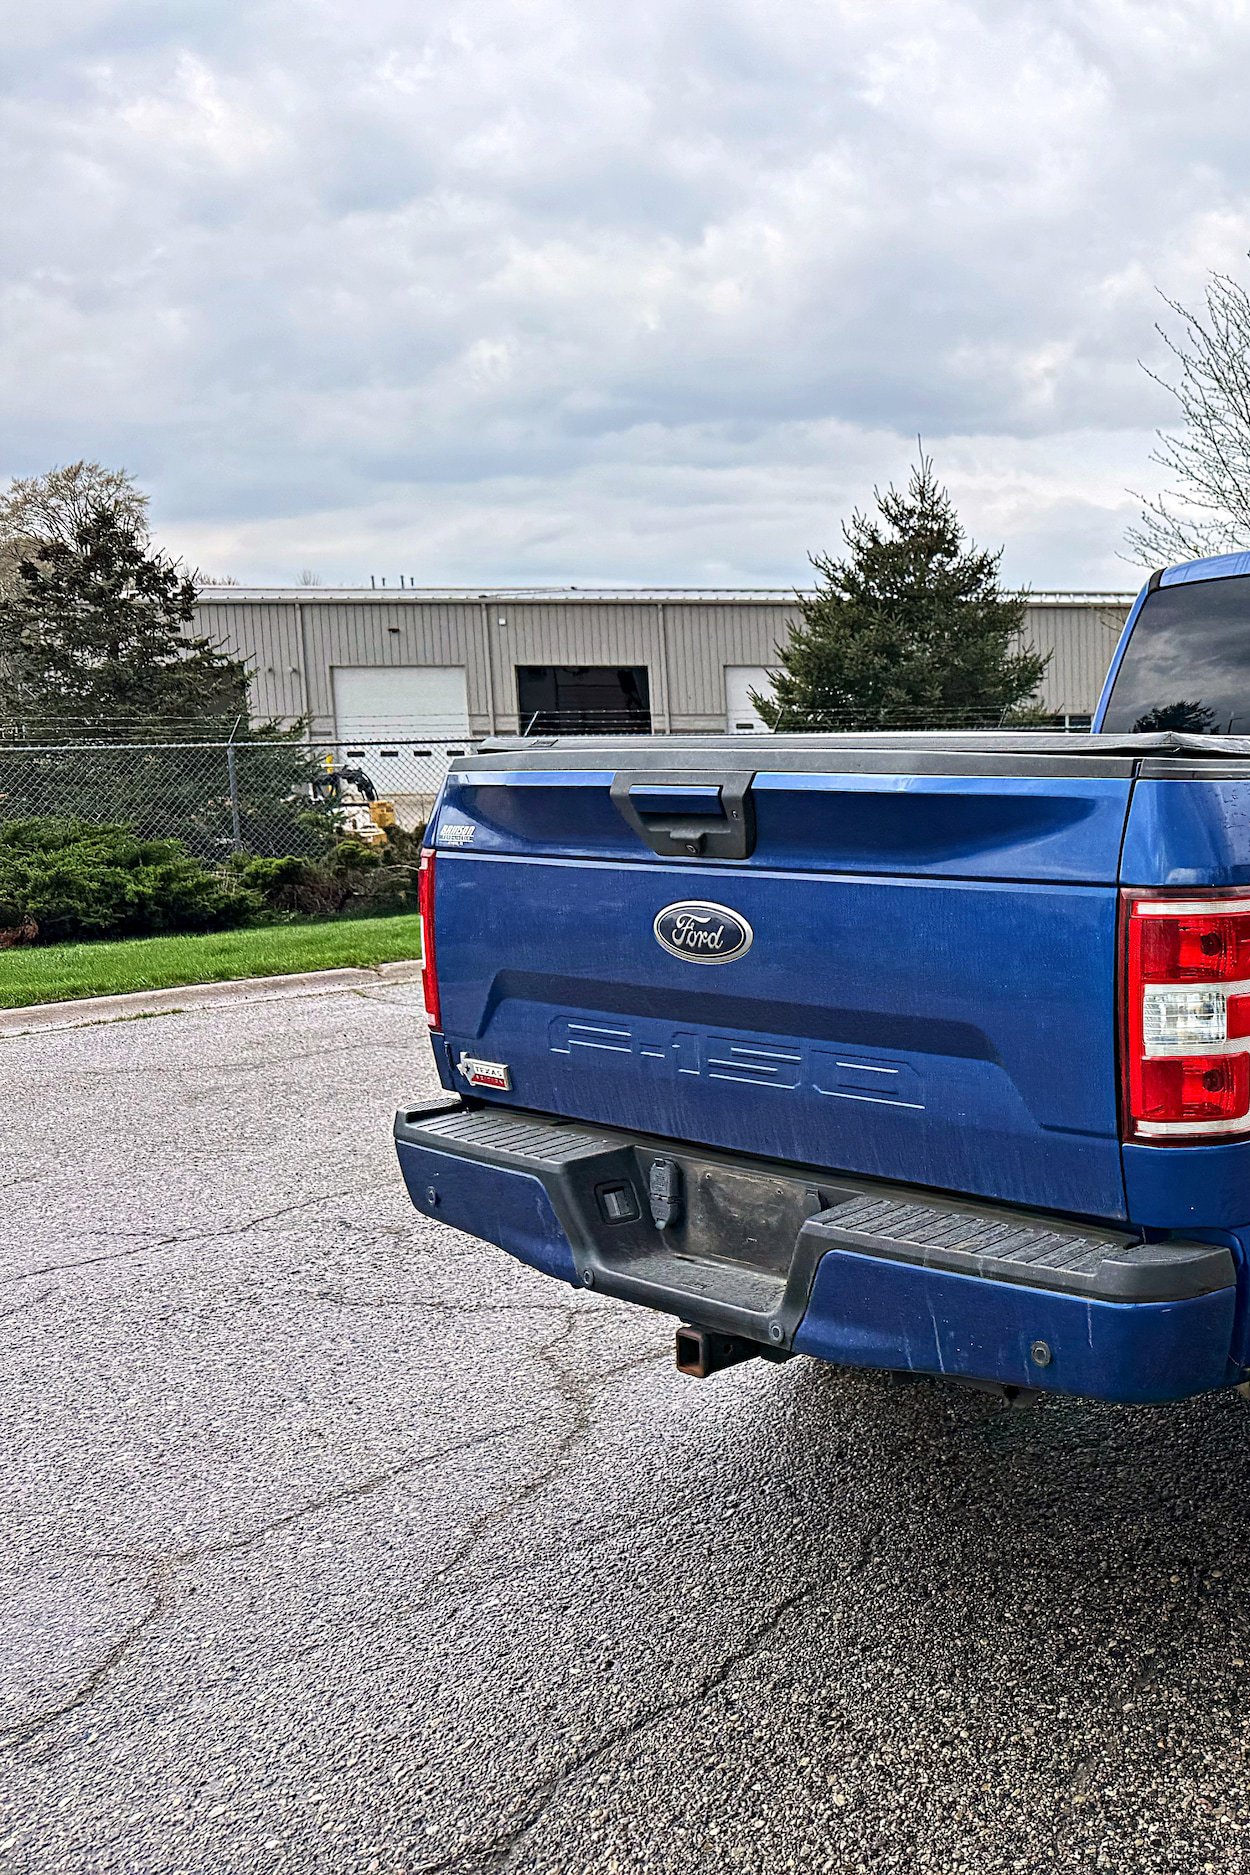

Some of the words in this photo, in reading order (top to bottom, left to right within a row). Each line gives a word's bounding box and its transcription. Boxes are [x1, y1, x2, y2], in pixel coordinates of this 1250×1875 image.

[671, 913, 725, 950] Ford
[475, 1066, 503, 1077] TEXAS
[548, 1014, 926, 1110] F-150
